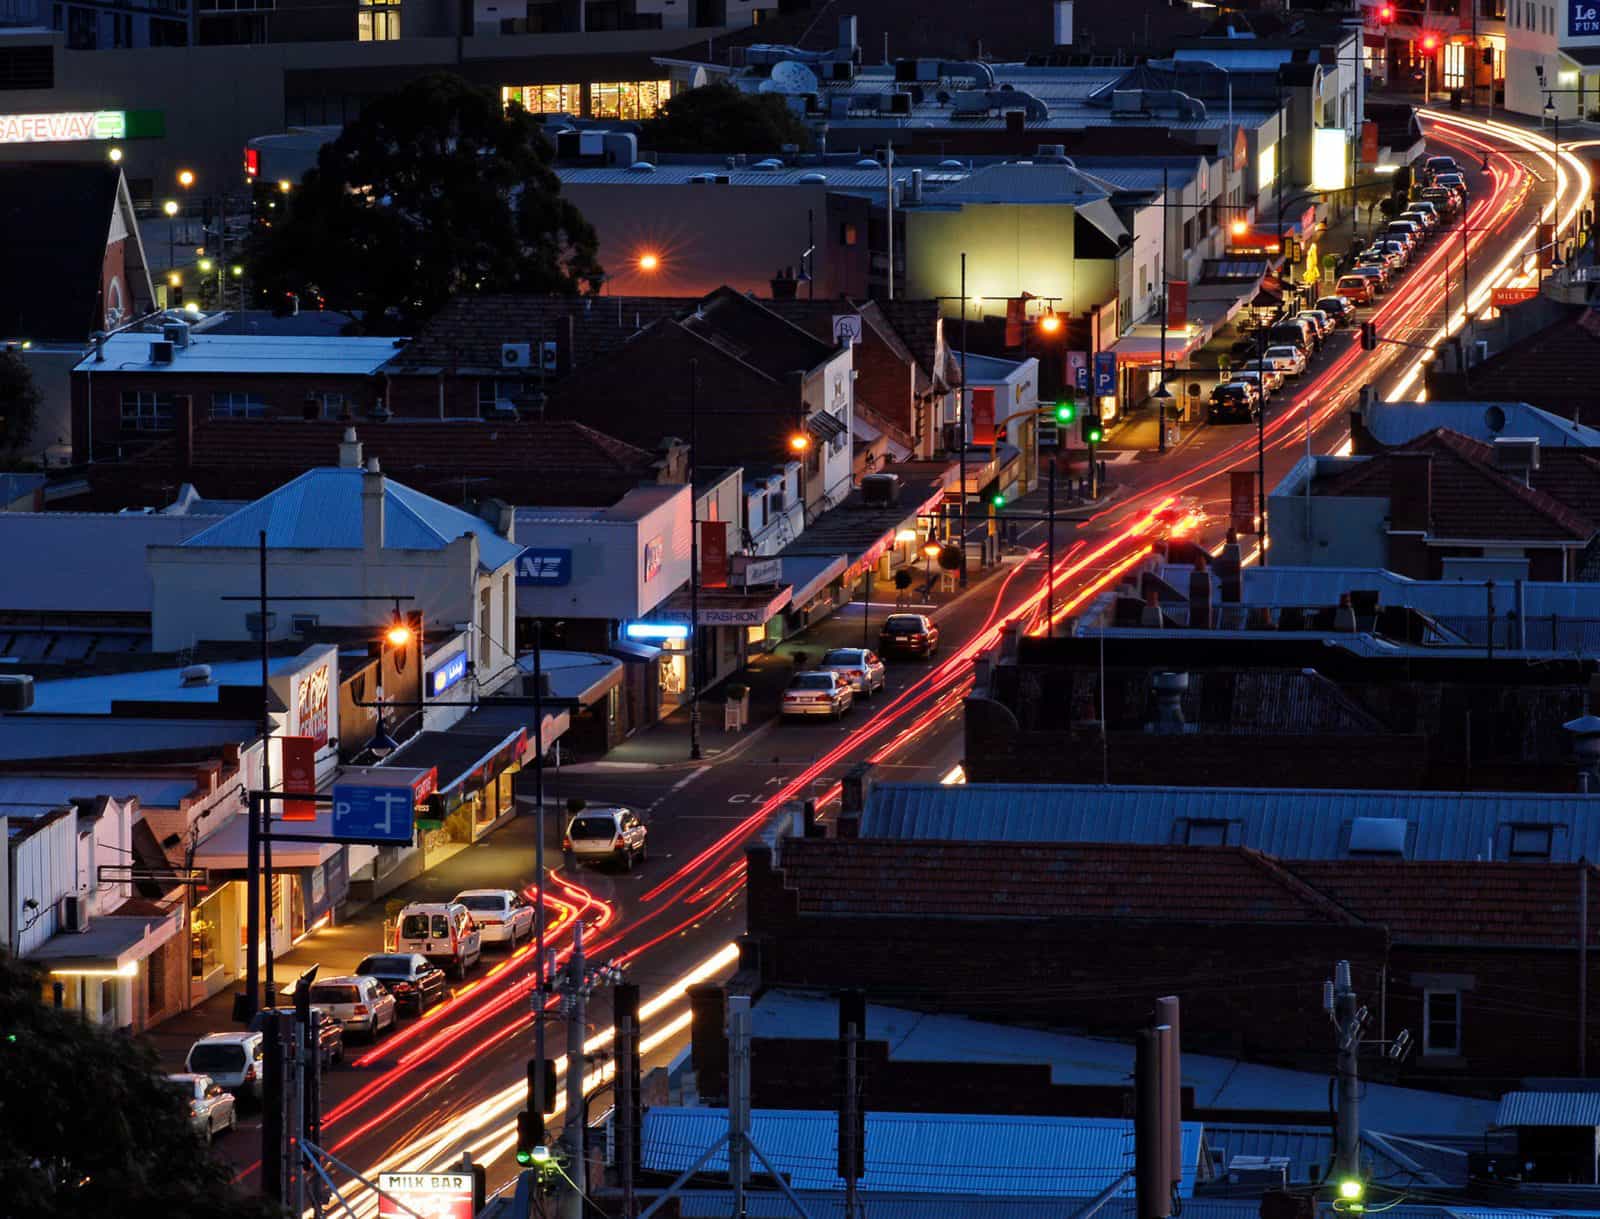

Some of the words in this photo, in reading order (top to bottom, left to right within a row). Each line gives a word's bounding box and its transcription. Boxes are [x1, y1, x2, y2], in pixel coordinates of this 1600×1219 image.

[1576, 5, 1597, 20] Le
[1099, 374, 1111, 388] P
[516, 556, 561, 577] NZ
[706, 612, 757, 621] FASHION
[335, 802, 350, 821] P
[389, 1176, 424, 1188] MILK
[432, 1177, 463, 1188] BAR
